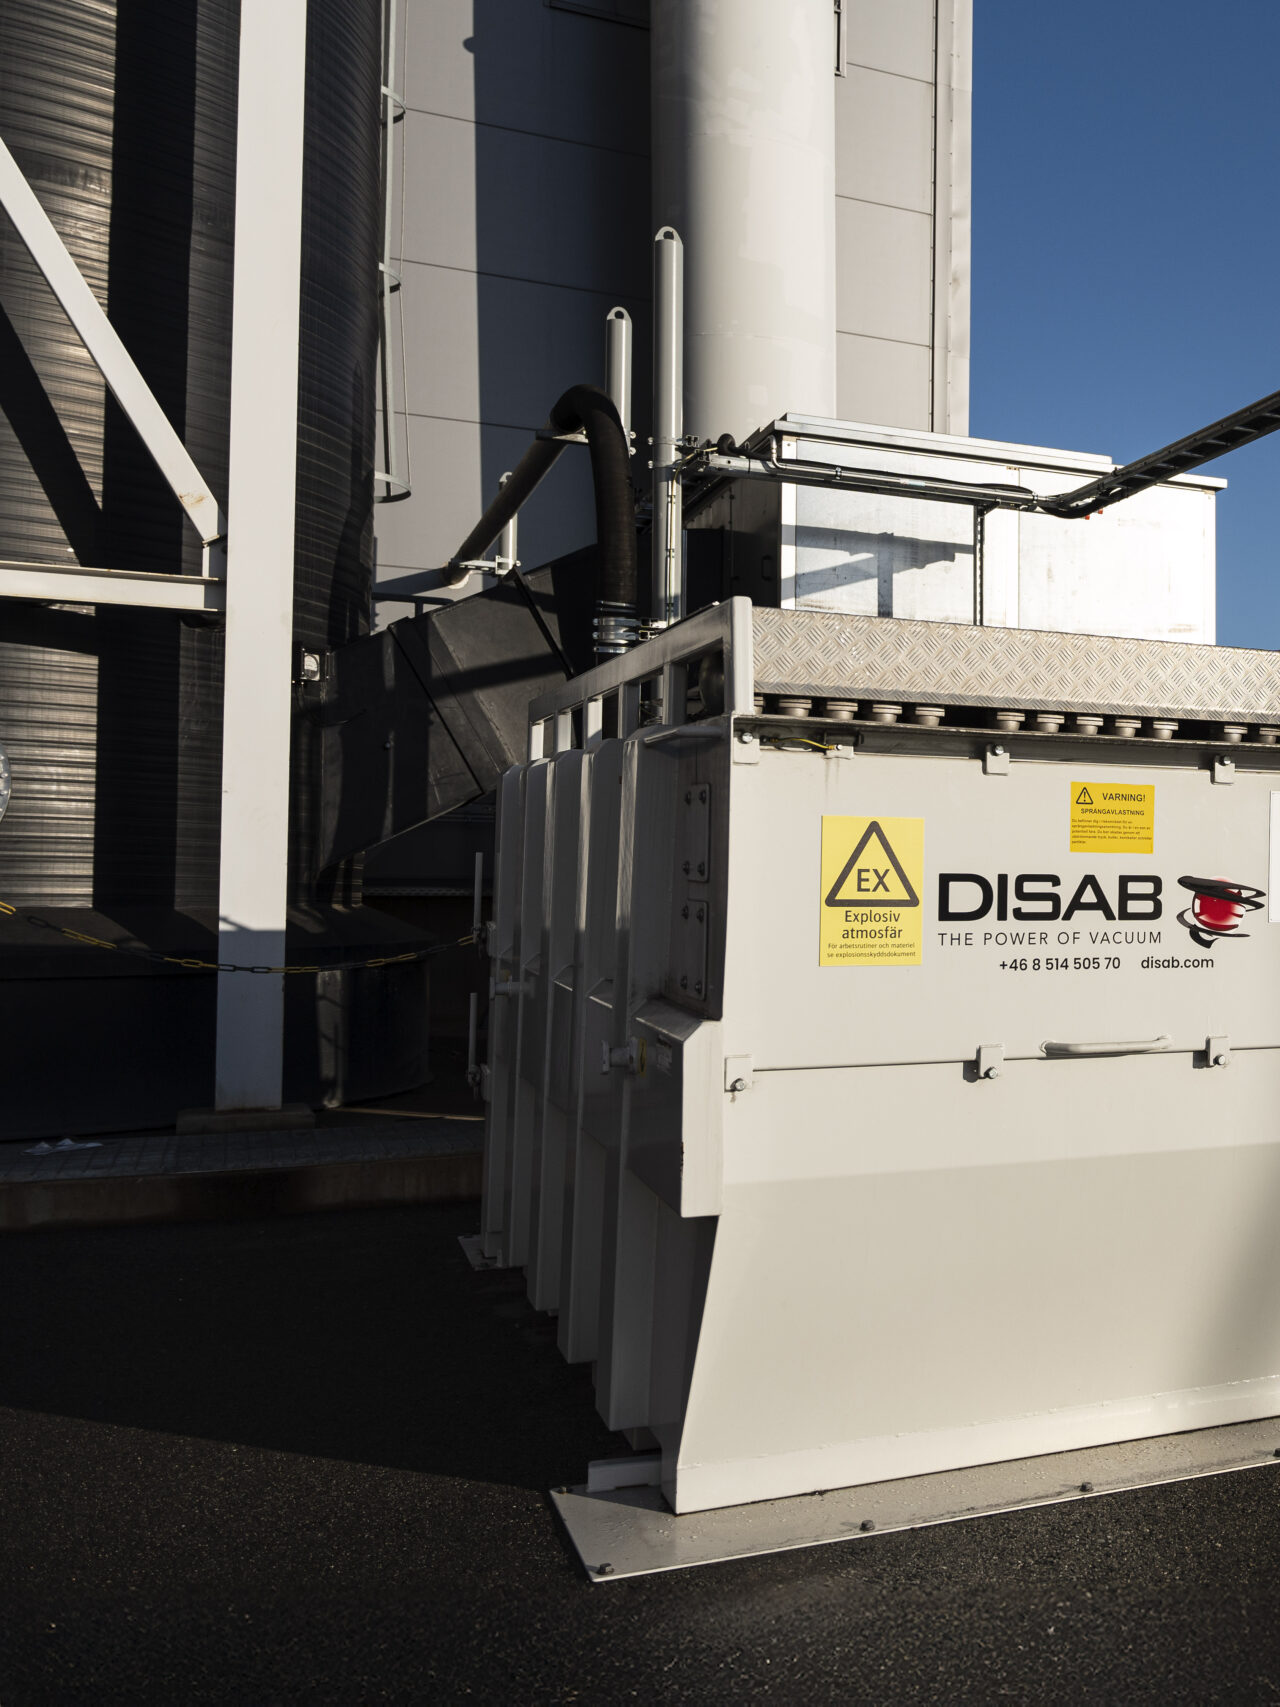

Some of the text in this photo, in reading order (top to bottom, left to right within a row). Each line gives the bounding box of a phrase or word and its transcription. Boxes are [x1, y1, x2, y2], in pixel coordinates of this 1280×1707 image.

[1102, 792, 1146, 803] VARNING!
[856, 868, 890, 893] EX
[938, 873, 1163, 922] DISAB
[844, 909, 901, 925] Explosiv
[841, 926, 903, 940] atmosfär
[938, 931, 1162, 946] THE POWER OF VACUUM
[999, 956, 1215, 971] +46 8 514 505 70 disab.com
